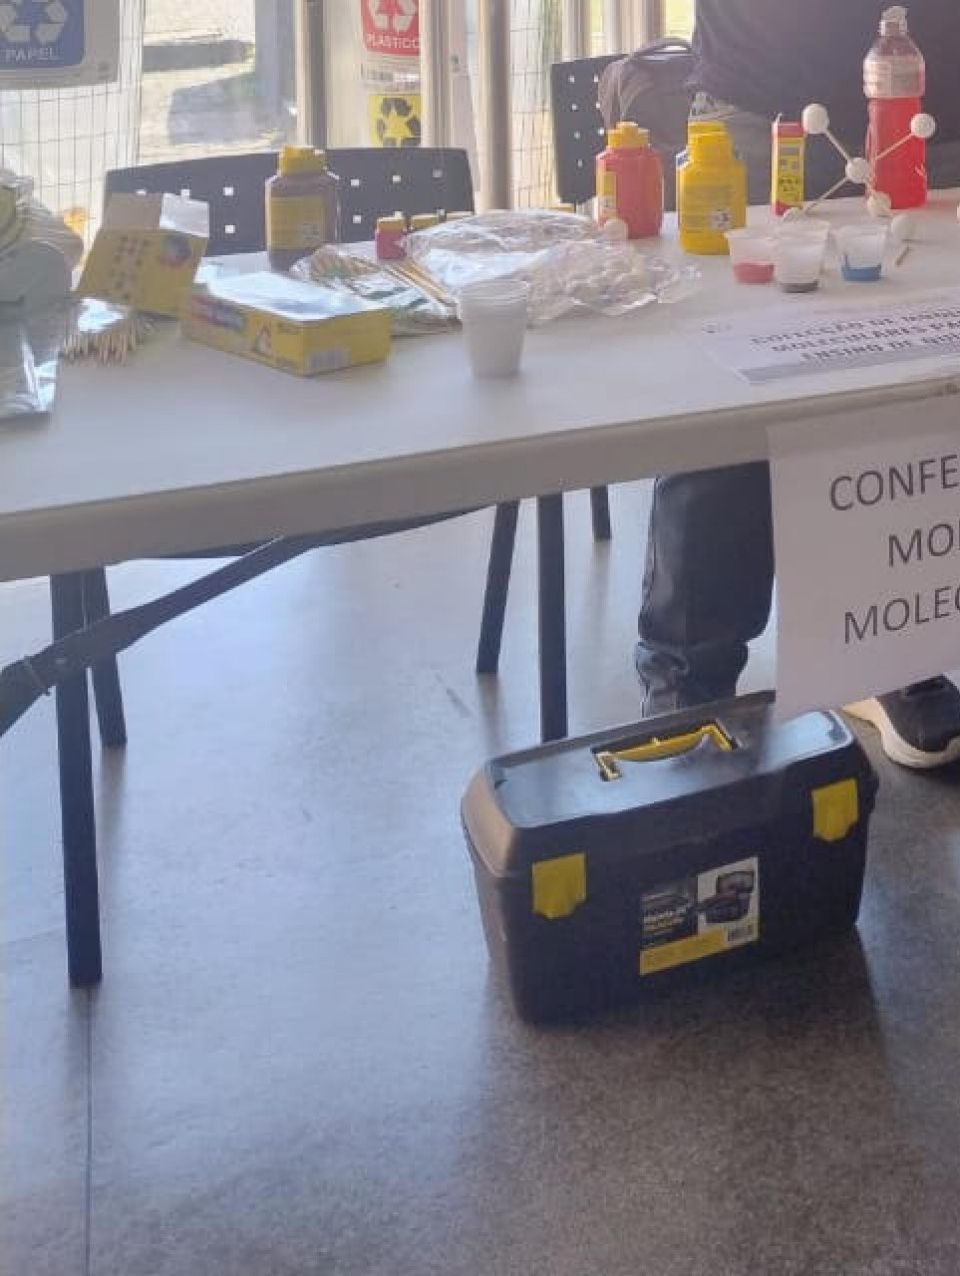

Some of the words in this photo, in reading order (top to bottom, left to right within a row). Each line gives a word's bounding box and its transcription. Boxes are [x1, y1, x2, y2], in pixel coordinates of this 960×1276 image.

[5, 46, 60, 62] PAPEL
[771, 326, 928, 352] MOLECULARES
[801, 341, 884, 361] ENSINO
